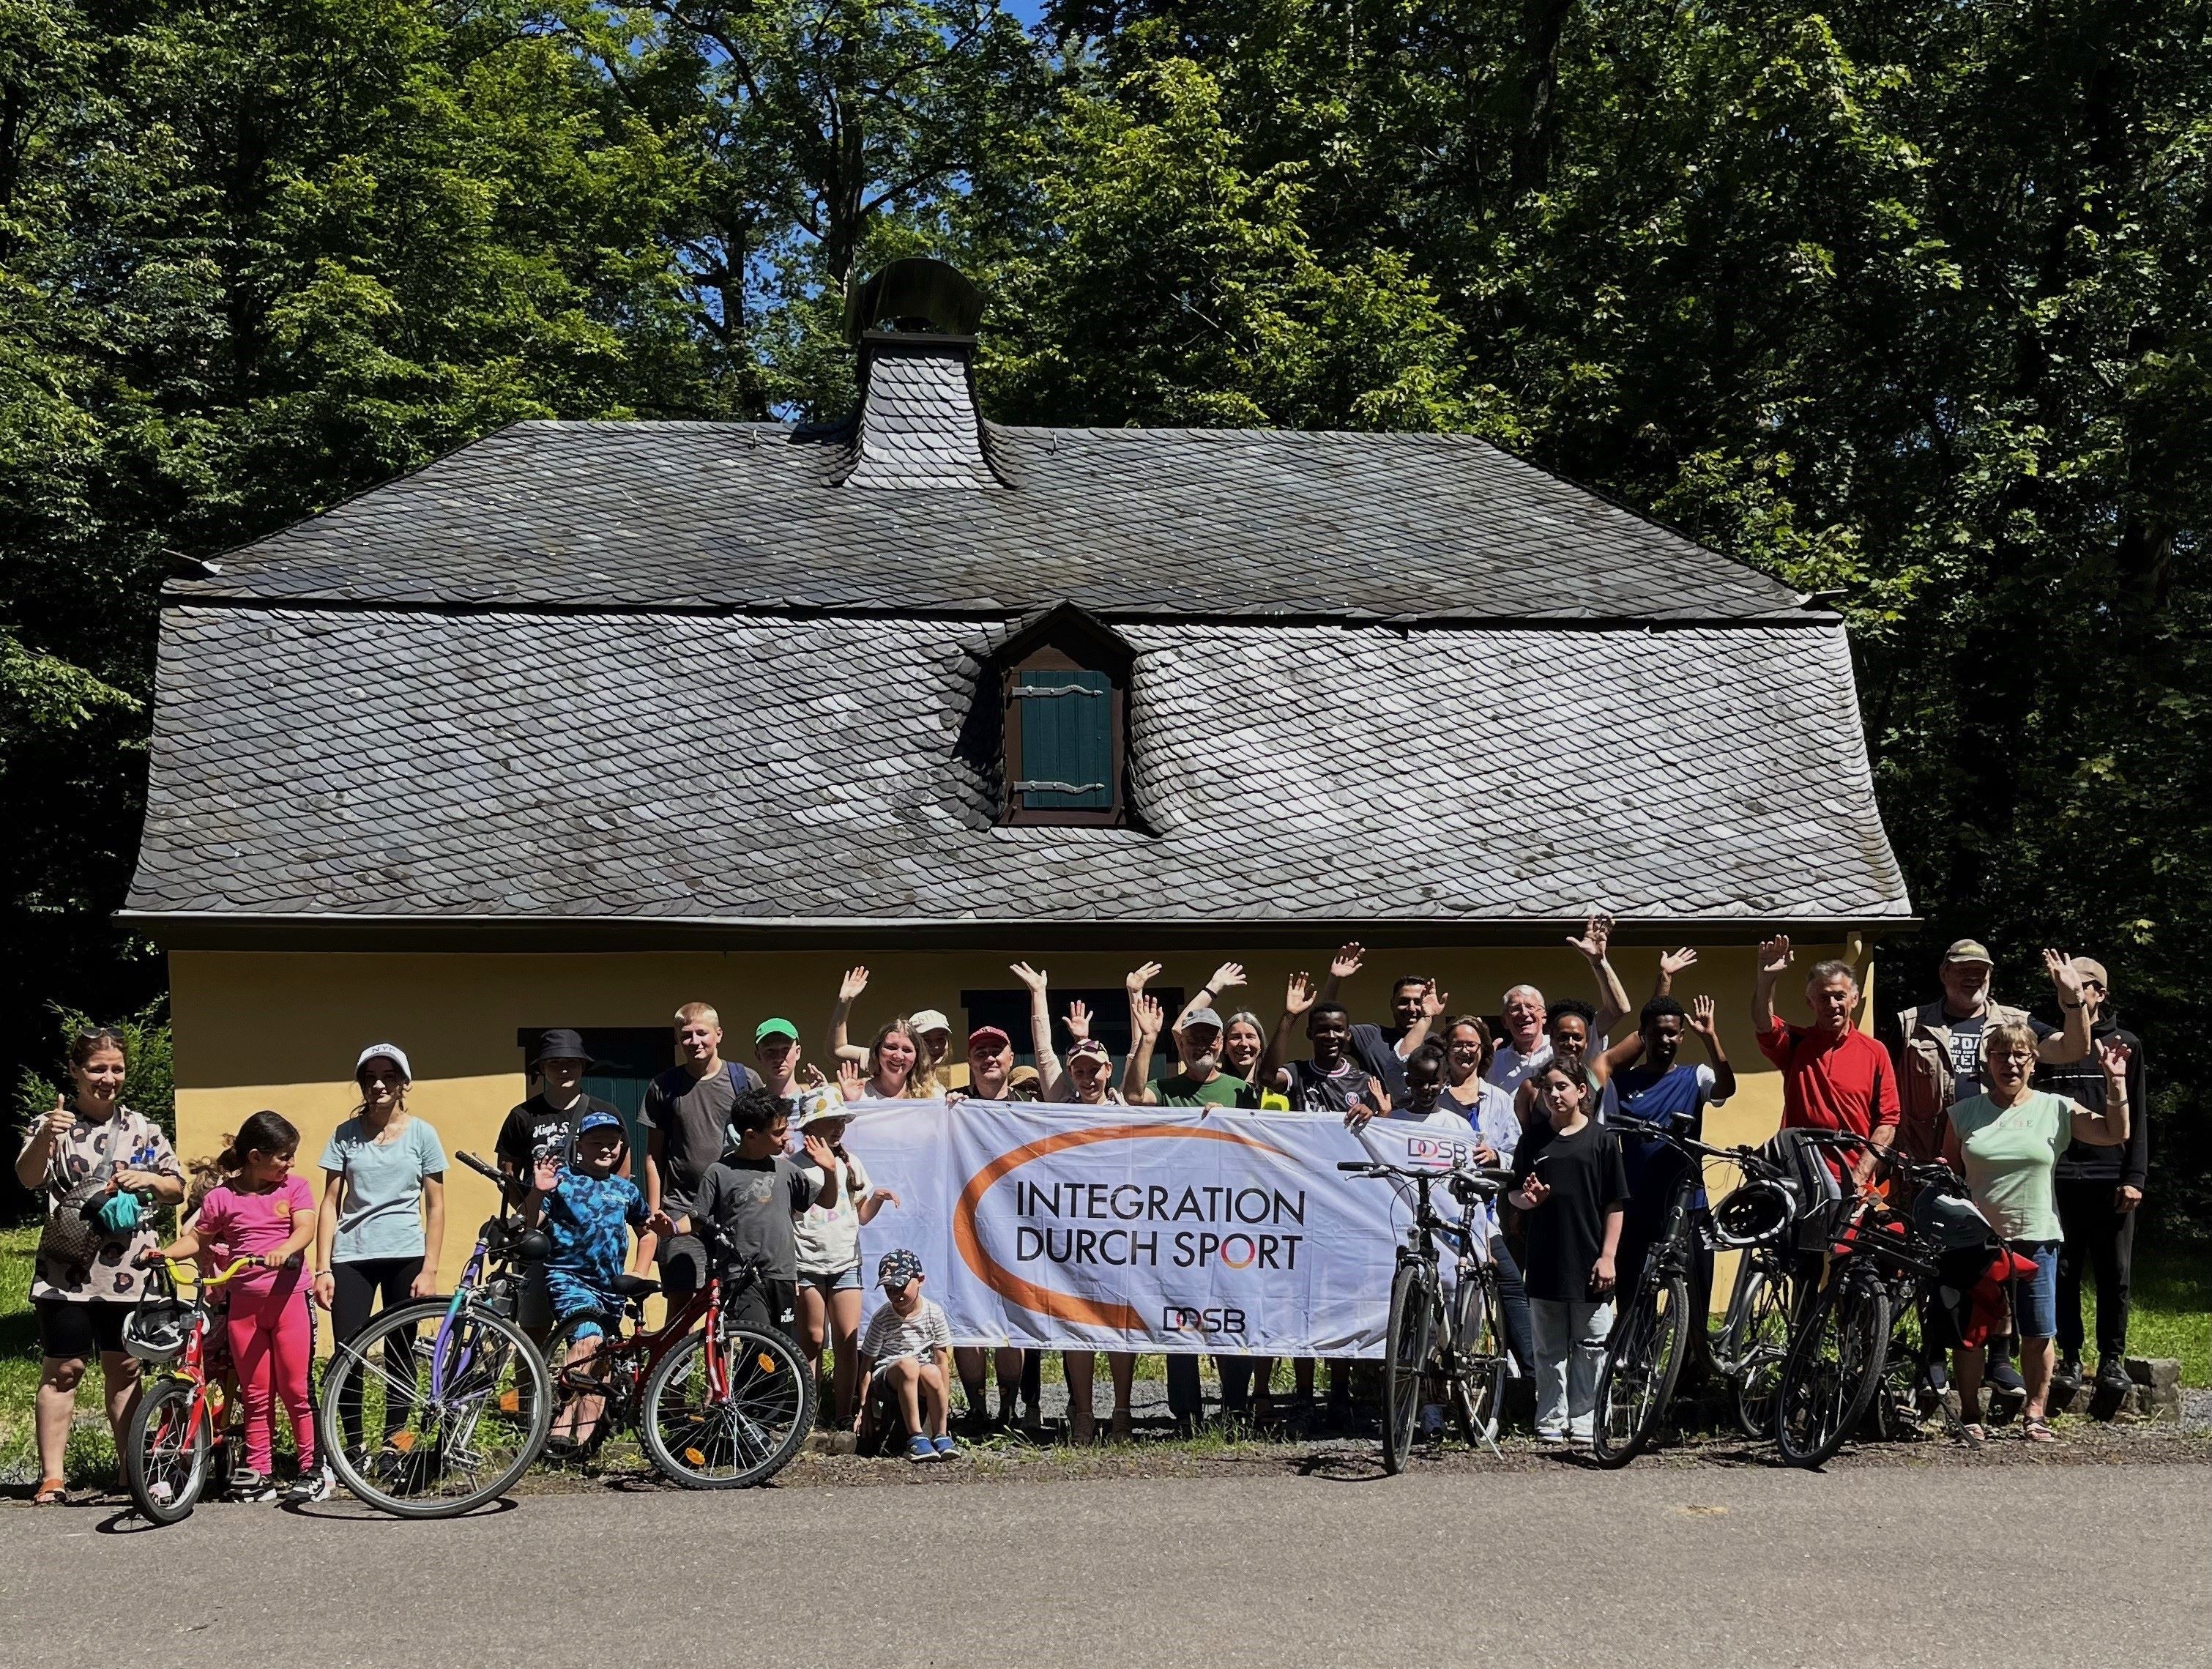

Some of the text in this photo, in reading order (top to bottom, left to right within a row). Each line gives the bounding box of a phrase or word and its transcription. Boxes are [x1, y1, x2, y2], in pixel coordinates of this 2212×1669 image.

[532, 1122, 558, 1138] High
[1407, 1137, 1467, 1163] DOSB
[1016, 1180, 1306, 1227] INTEGRATION
[1016, 1226, 1303, 1270] DURCH SPORT
[1163, 1306, 1245, 1334] DOSB
